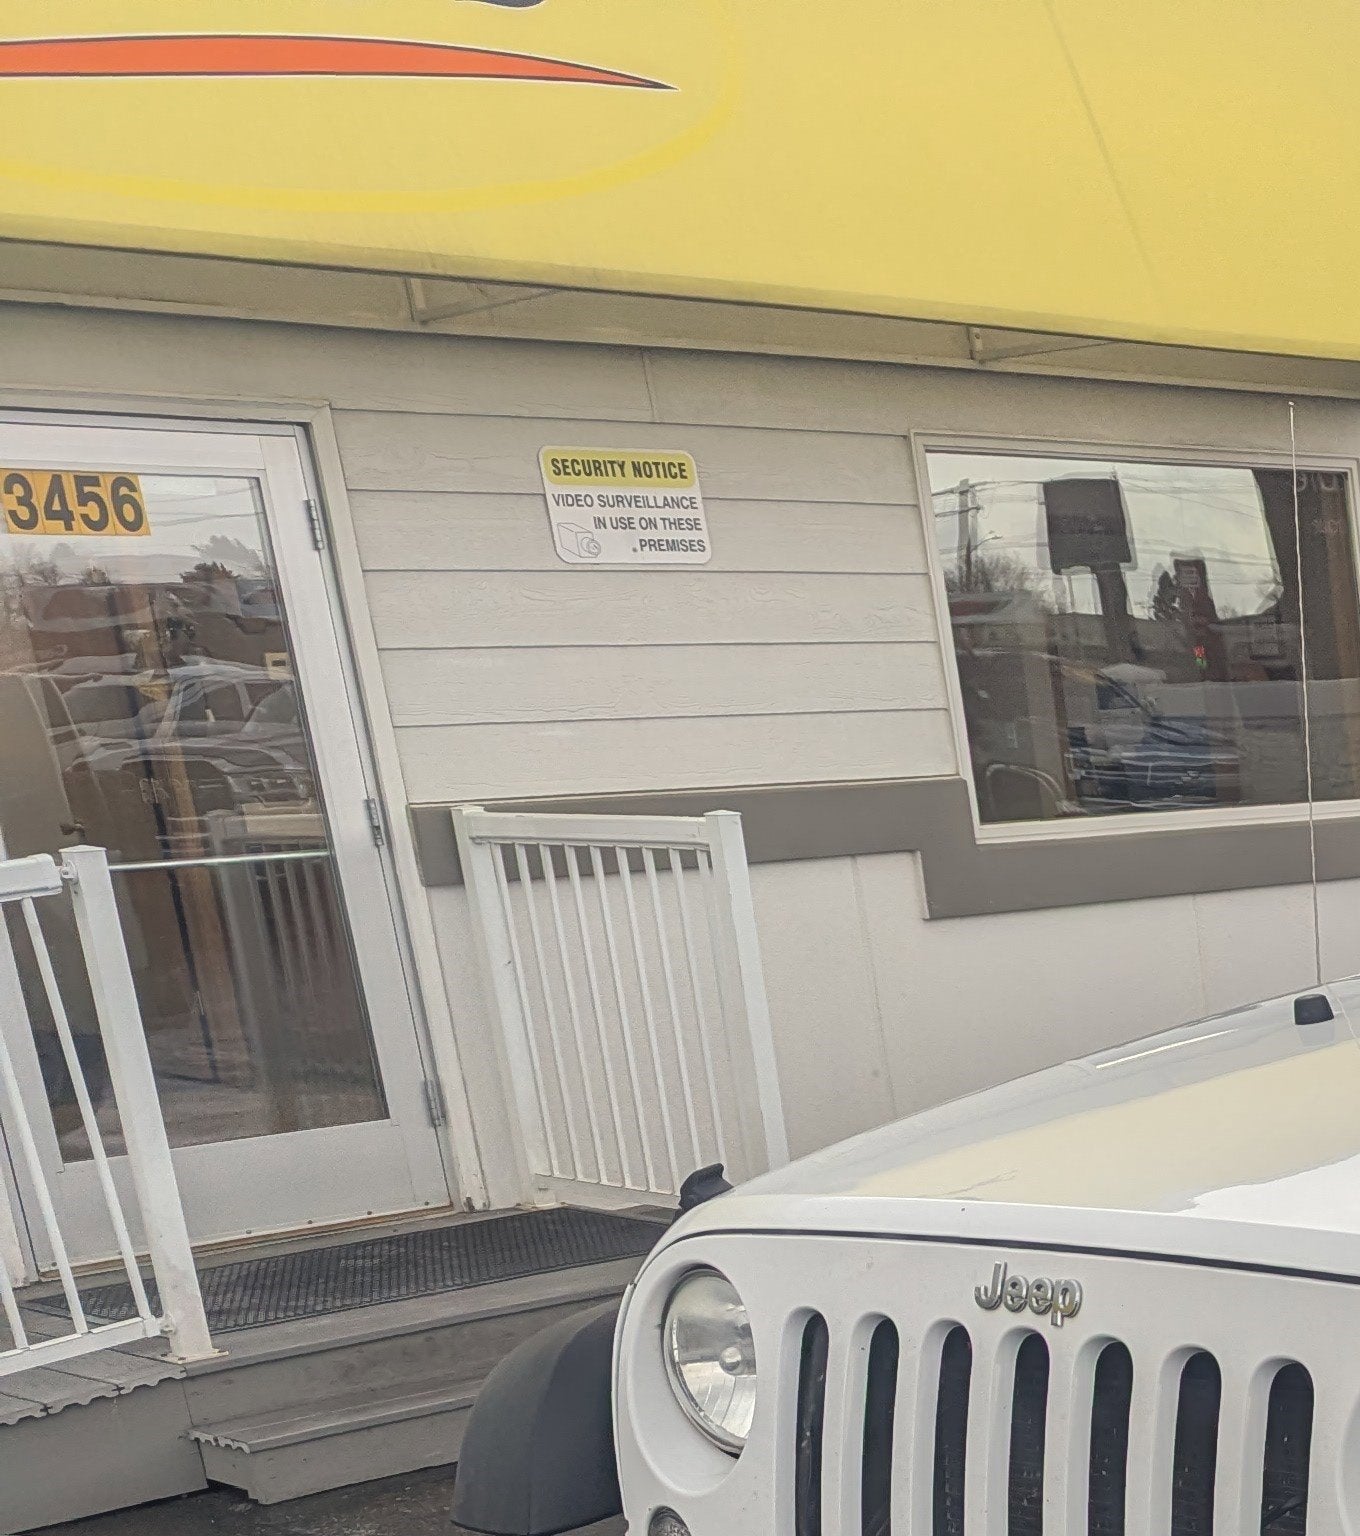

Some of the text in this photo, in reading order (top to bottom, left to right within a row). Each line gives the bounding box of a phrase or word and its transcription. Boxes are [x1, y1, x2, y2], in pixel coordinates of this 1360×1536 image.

[551, 458, 688, 479] SECURITY NOTICE
[3, 472, 144, 532] 3456
[552, 494, 698, 509] VIDEO SURVEILLANCE
[593, 516, 702, 530] IN USE ON THESE
[974, 1261, 1083, 1327] Jeep
